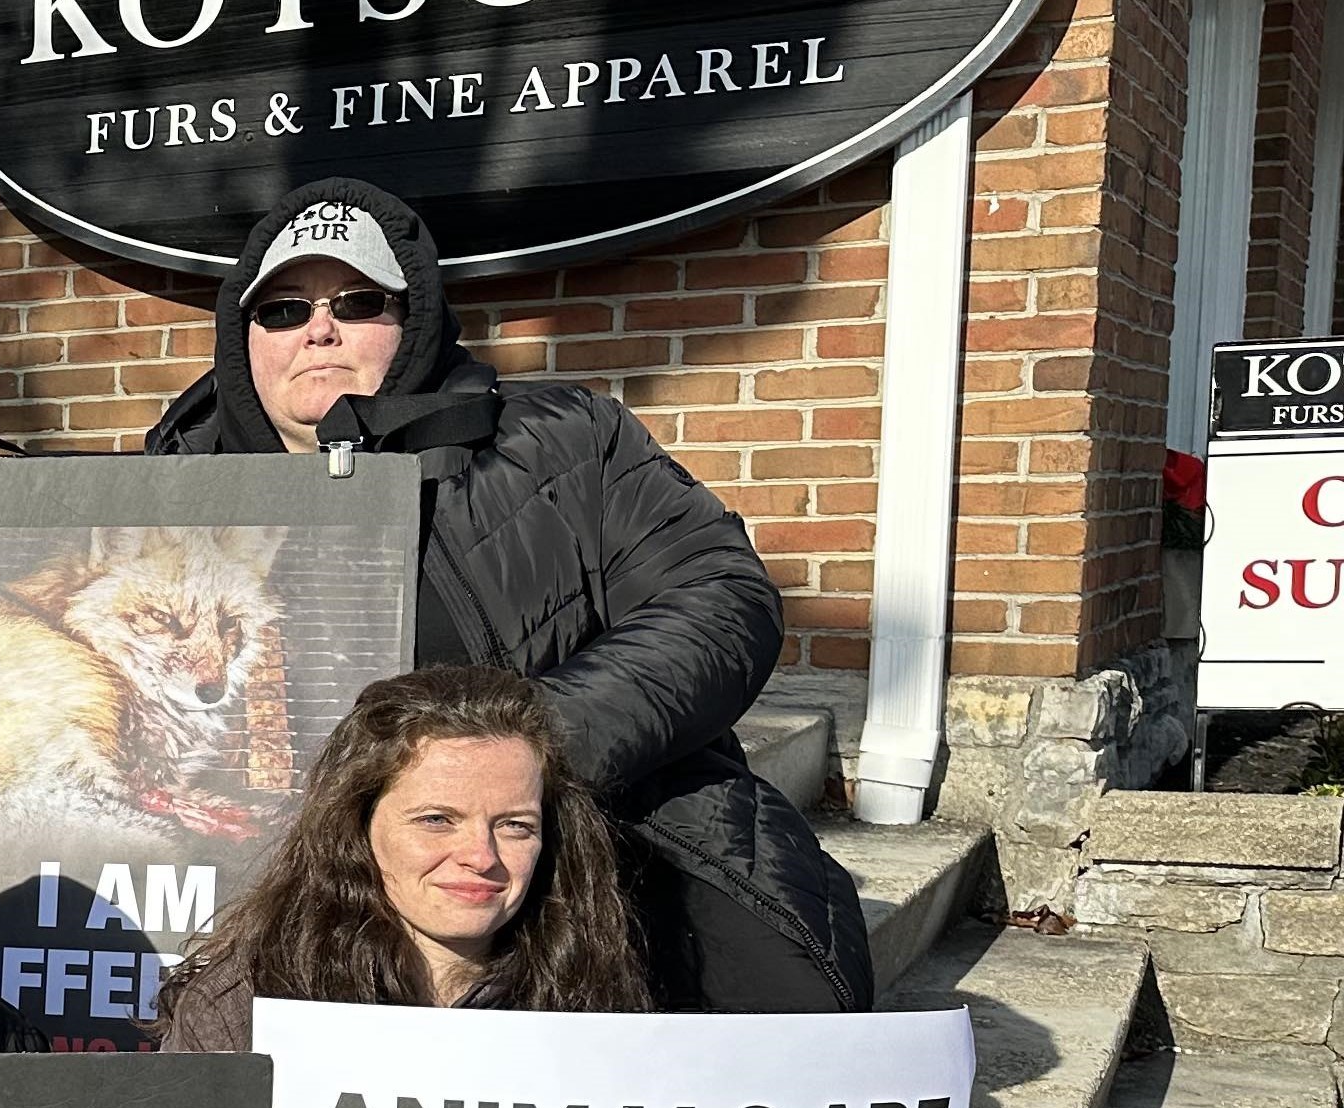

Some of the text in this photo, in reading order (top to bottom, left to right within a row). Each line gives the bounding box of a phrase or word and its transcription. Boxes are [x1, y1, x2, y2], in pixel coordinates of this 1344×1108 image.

[86, 37, 845, 154] FURS & FINE APPAREL
[291, 223, 350, 247] FUR
[1272, 404, 1344, 425] FURS
[37, 861, 217, 933] I AM
